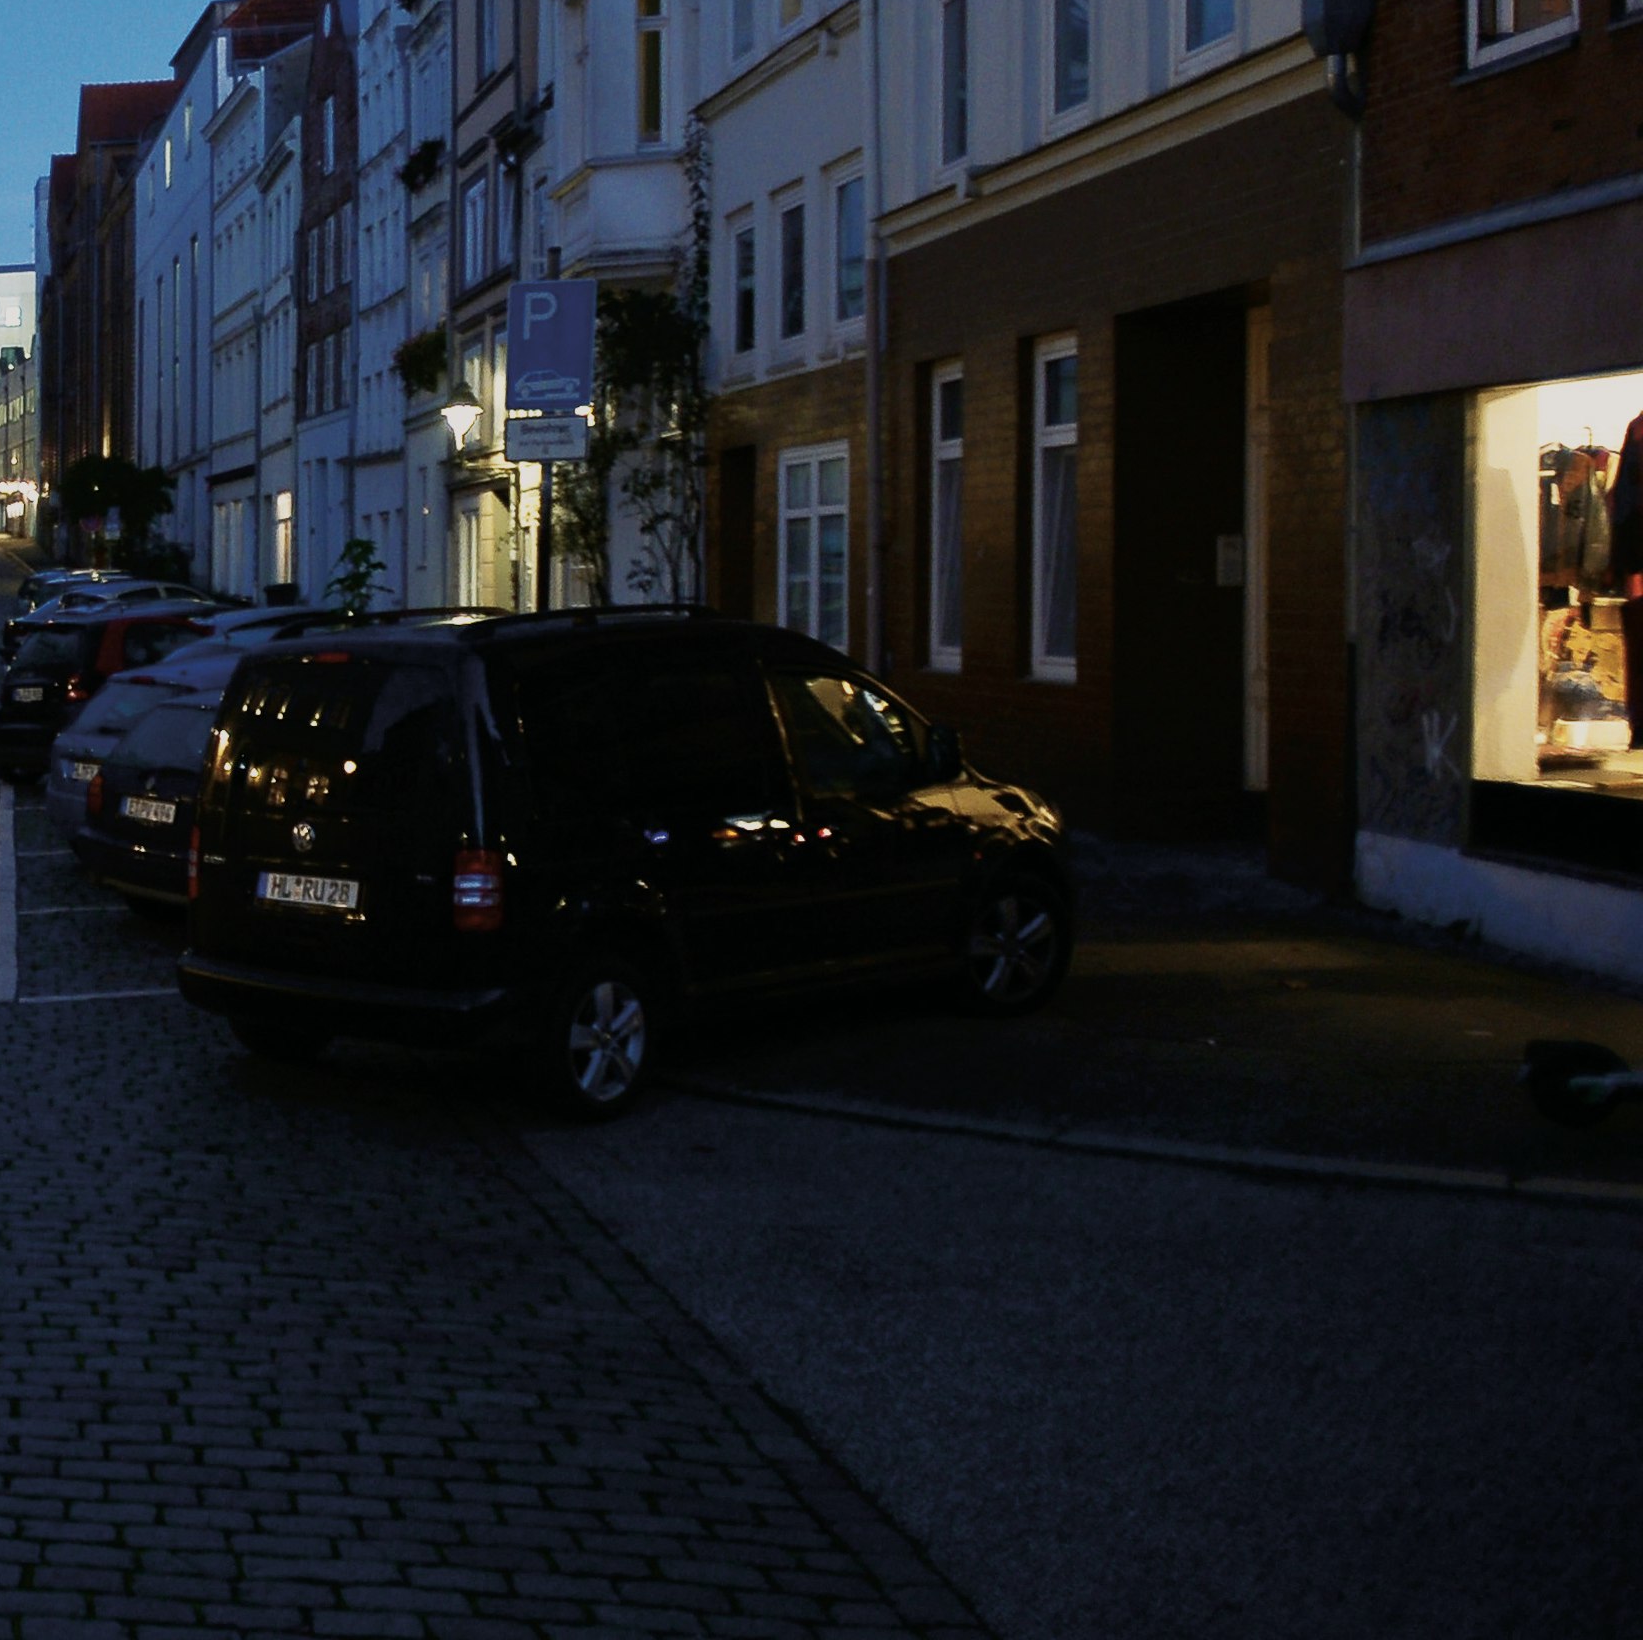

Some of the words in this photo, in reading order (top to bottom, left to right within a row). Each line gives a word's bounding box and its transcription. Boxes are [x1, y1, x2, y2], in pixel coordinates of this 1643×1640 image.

[523, 292, 558, 340] P
[270, 874, 292, 898] HL
[302, 878, 325, 901] RU
